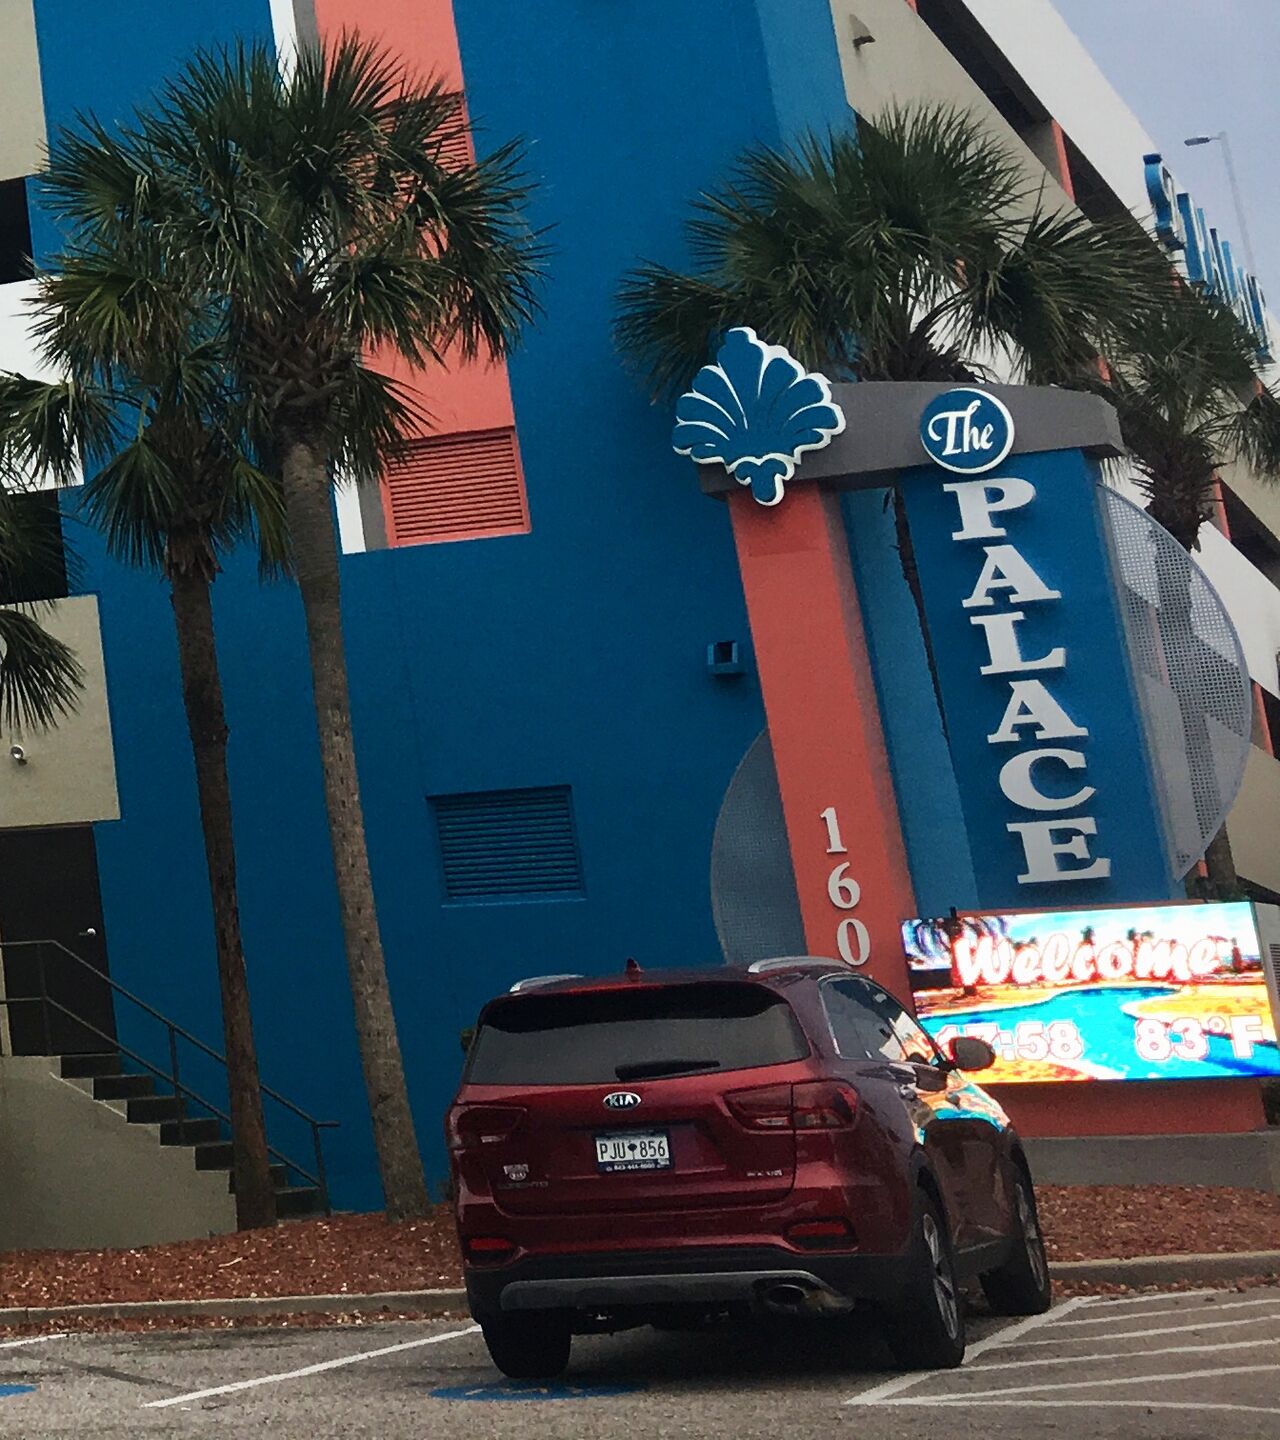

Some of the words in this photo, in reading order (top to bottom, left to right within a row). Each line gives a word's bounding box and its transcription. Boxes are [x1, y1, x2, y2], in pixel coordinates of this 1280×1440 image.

[928, 399, 994, 456] The
[943, 477, 1111, 885] PALACE
[820, 807, 871, 966] 160
[952, 933, 1224, 986] Welcome
[608, 1094, 634, 1107] KIA
[600, 1142, 627, 1161] PJU
[640, 1140, 667, 1158] 856
